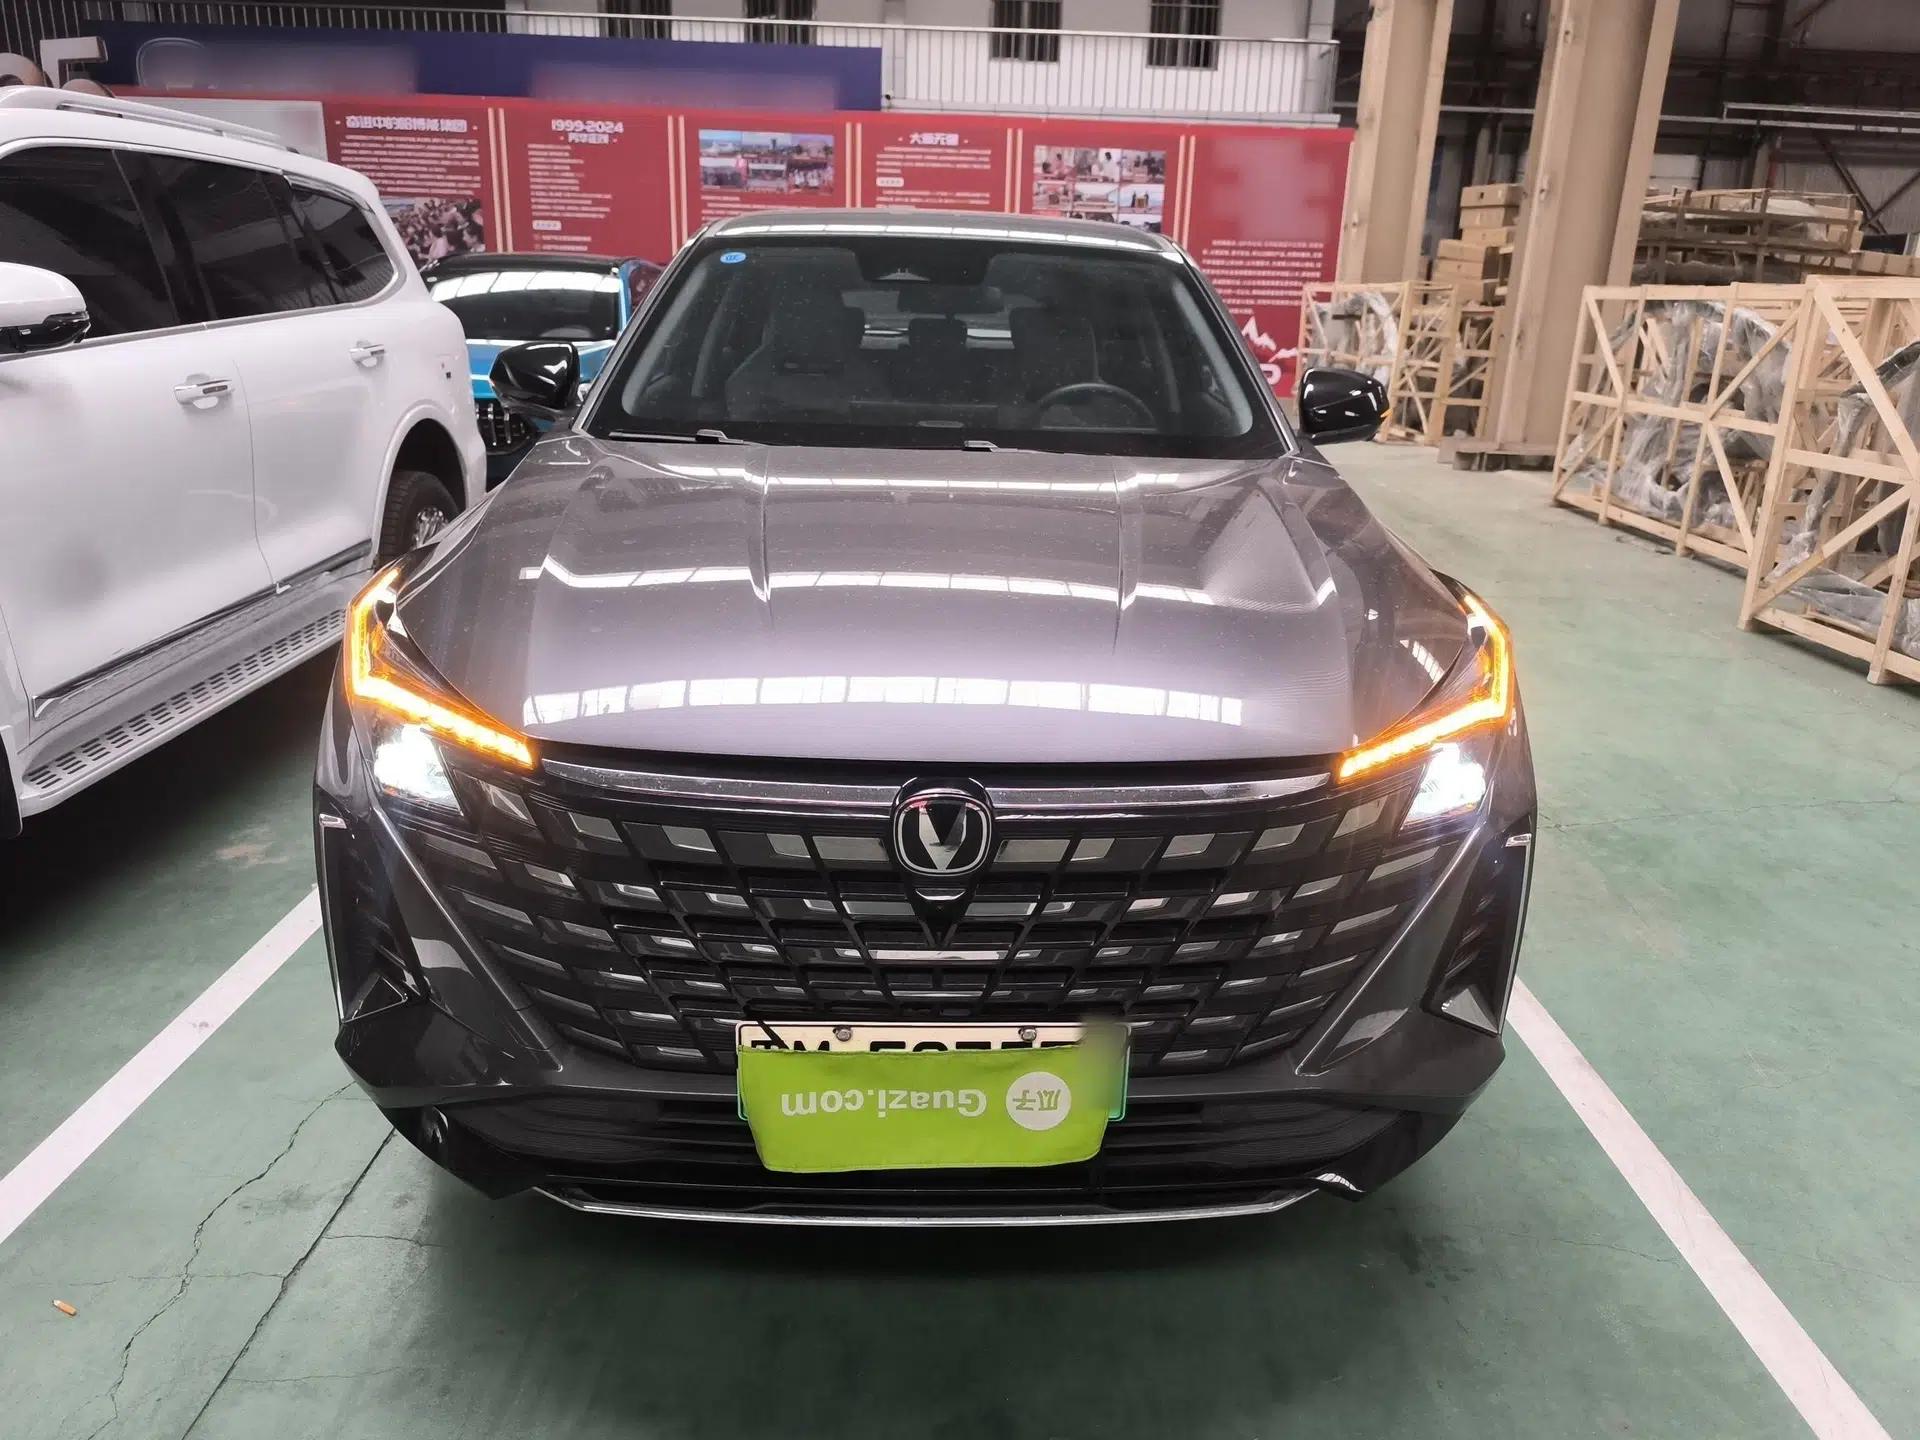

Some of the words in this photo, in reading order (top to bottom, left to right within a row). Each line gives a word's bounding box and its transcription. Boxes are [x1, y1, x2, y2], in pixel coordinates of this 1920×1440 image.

[551, 119, 624, 133] 1999-2024
[781, 1089, 987, 1117] Guazi.com
[1012, 1088, 1061, 1111] 瓜子
